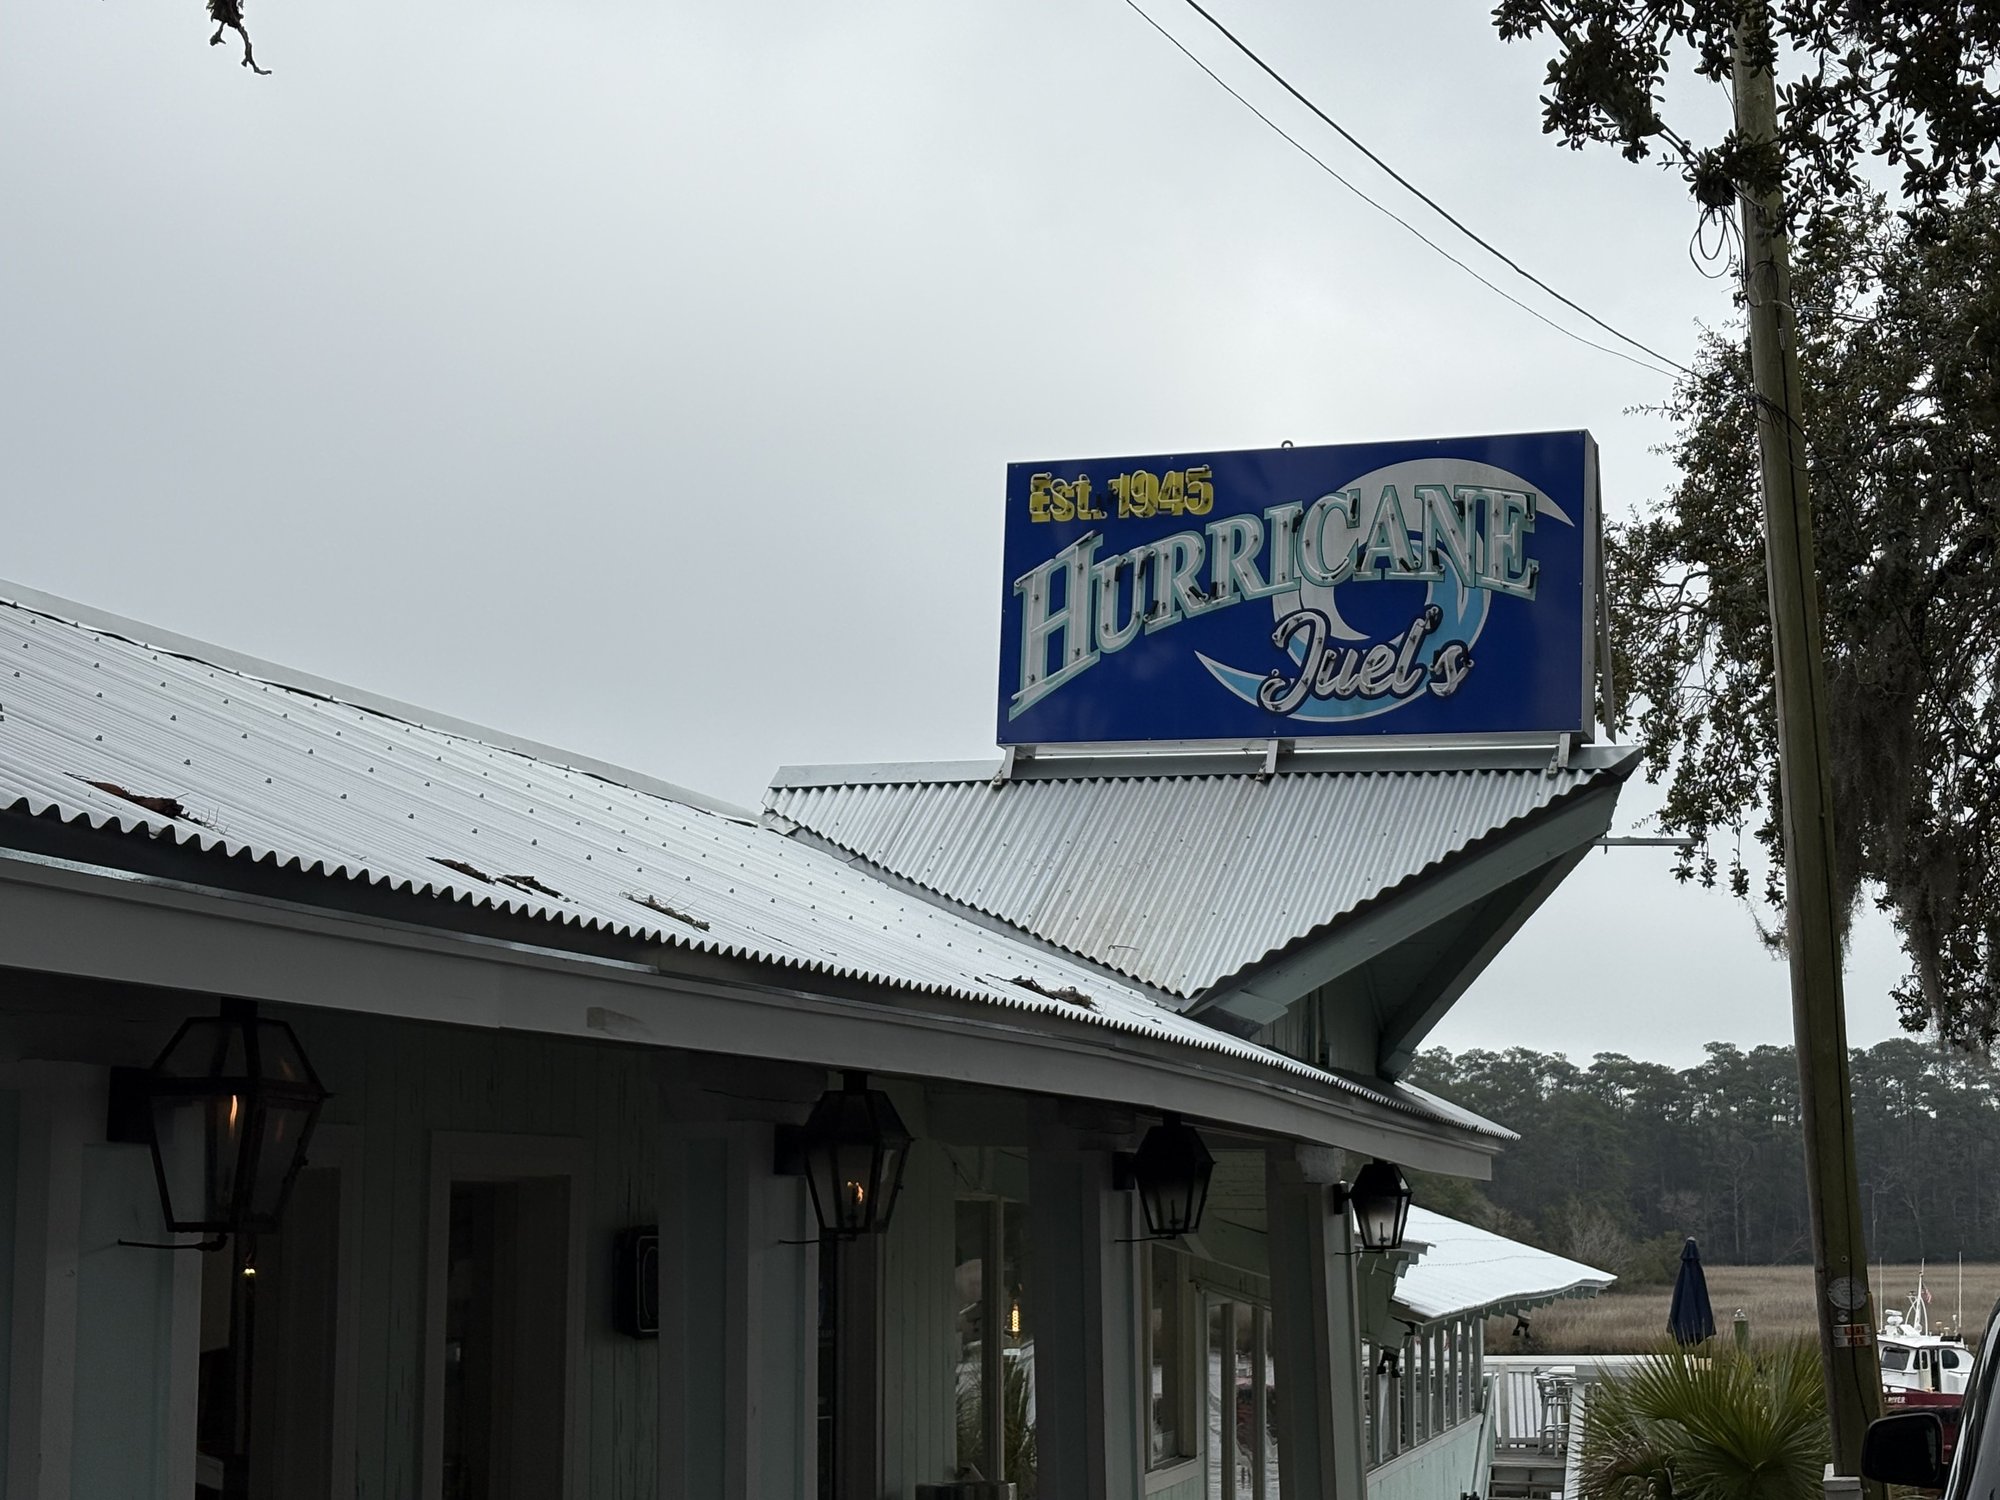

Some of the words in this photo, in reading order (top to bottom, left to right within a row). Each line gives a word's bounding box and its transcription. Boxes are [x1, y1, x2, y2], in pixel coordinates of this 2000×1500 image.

[1029, 471, 1107, 523] Est.
[1108, 464, 1214, 519] 1945
[1008, 484, 1539, 722] HURRICANE
[1260, 606, 1475, 712] Juel's
